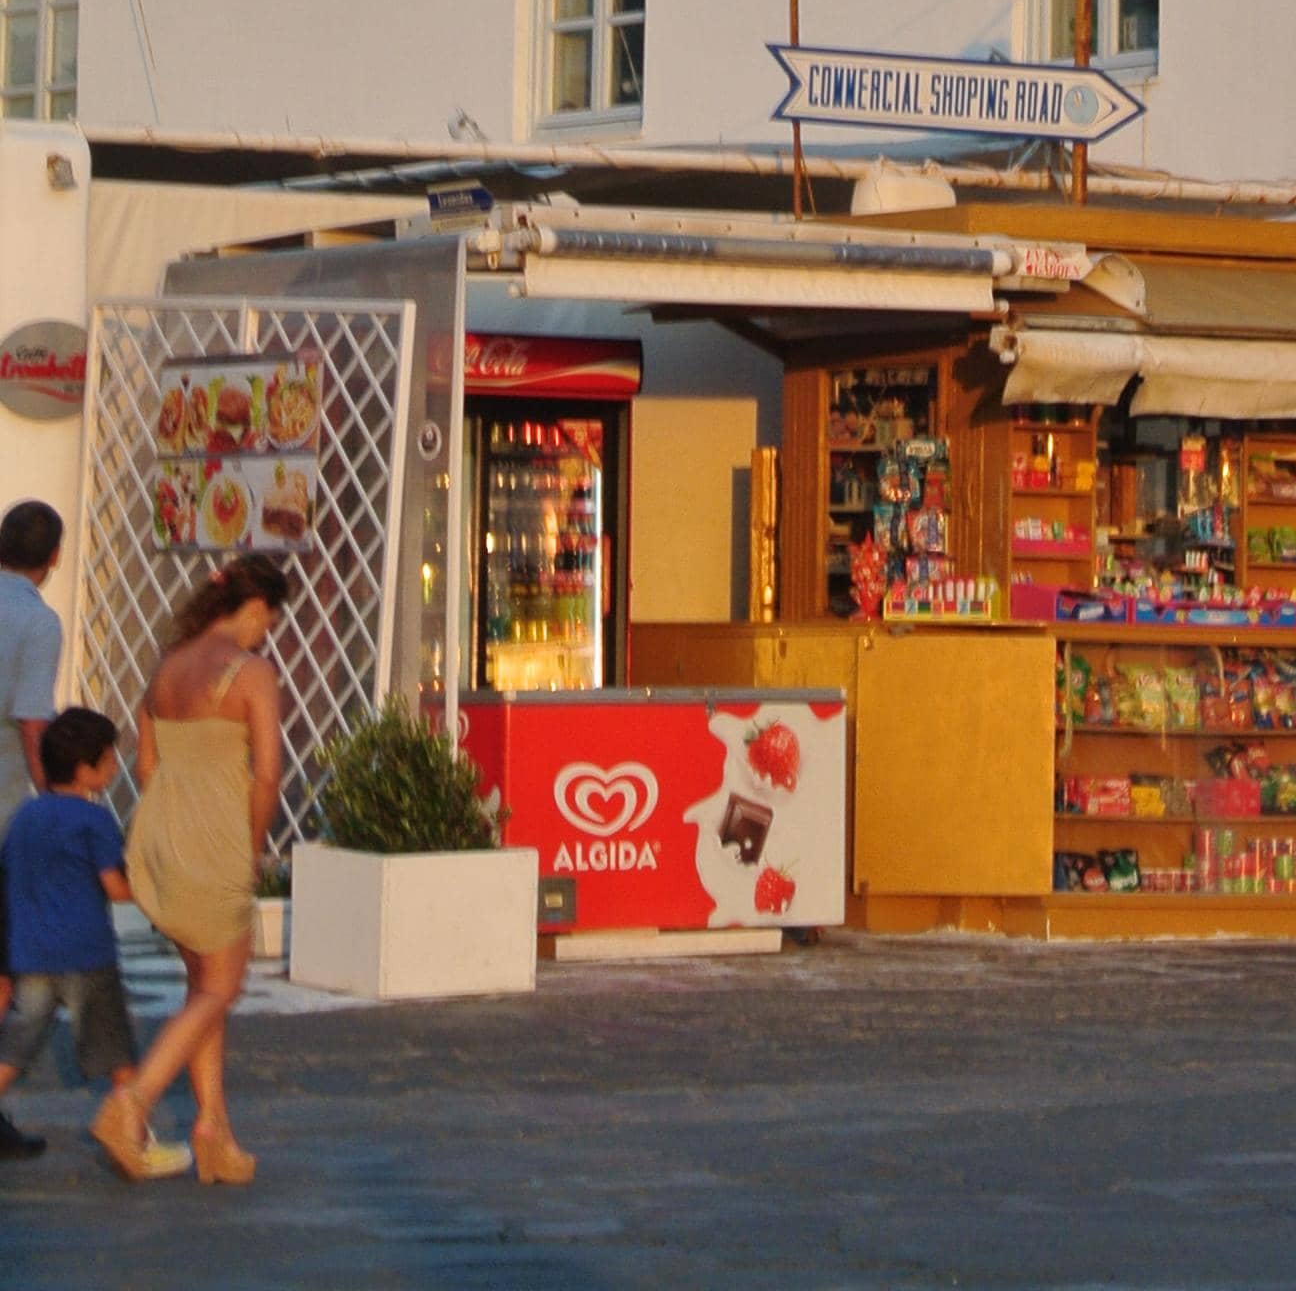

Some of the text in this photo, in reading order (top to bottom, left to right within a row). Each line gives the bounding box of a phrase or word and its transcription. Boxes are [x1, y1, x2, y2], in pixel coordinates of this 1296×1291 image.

[808, 64, 1063, 124] COMMERCIAL SHOPING ROAD
[553, 840, 657, 871] ALGIDA
